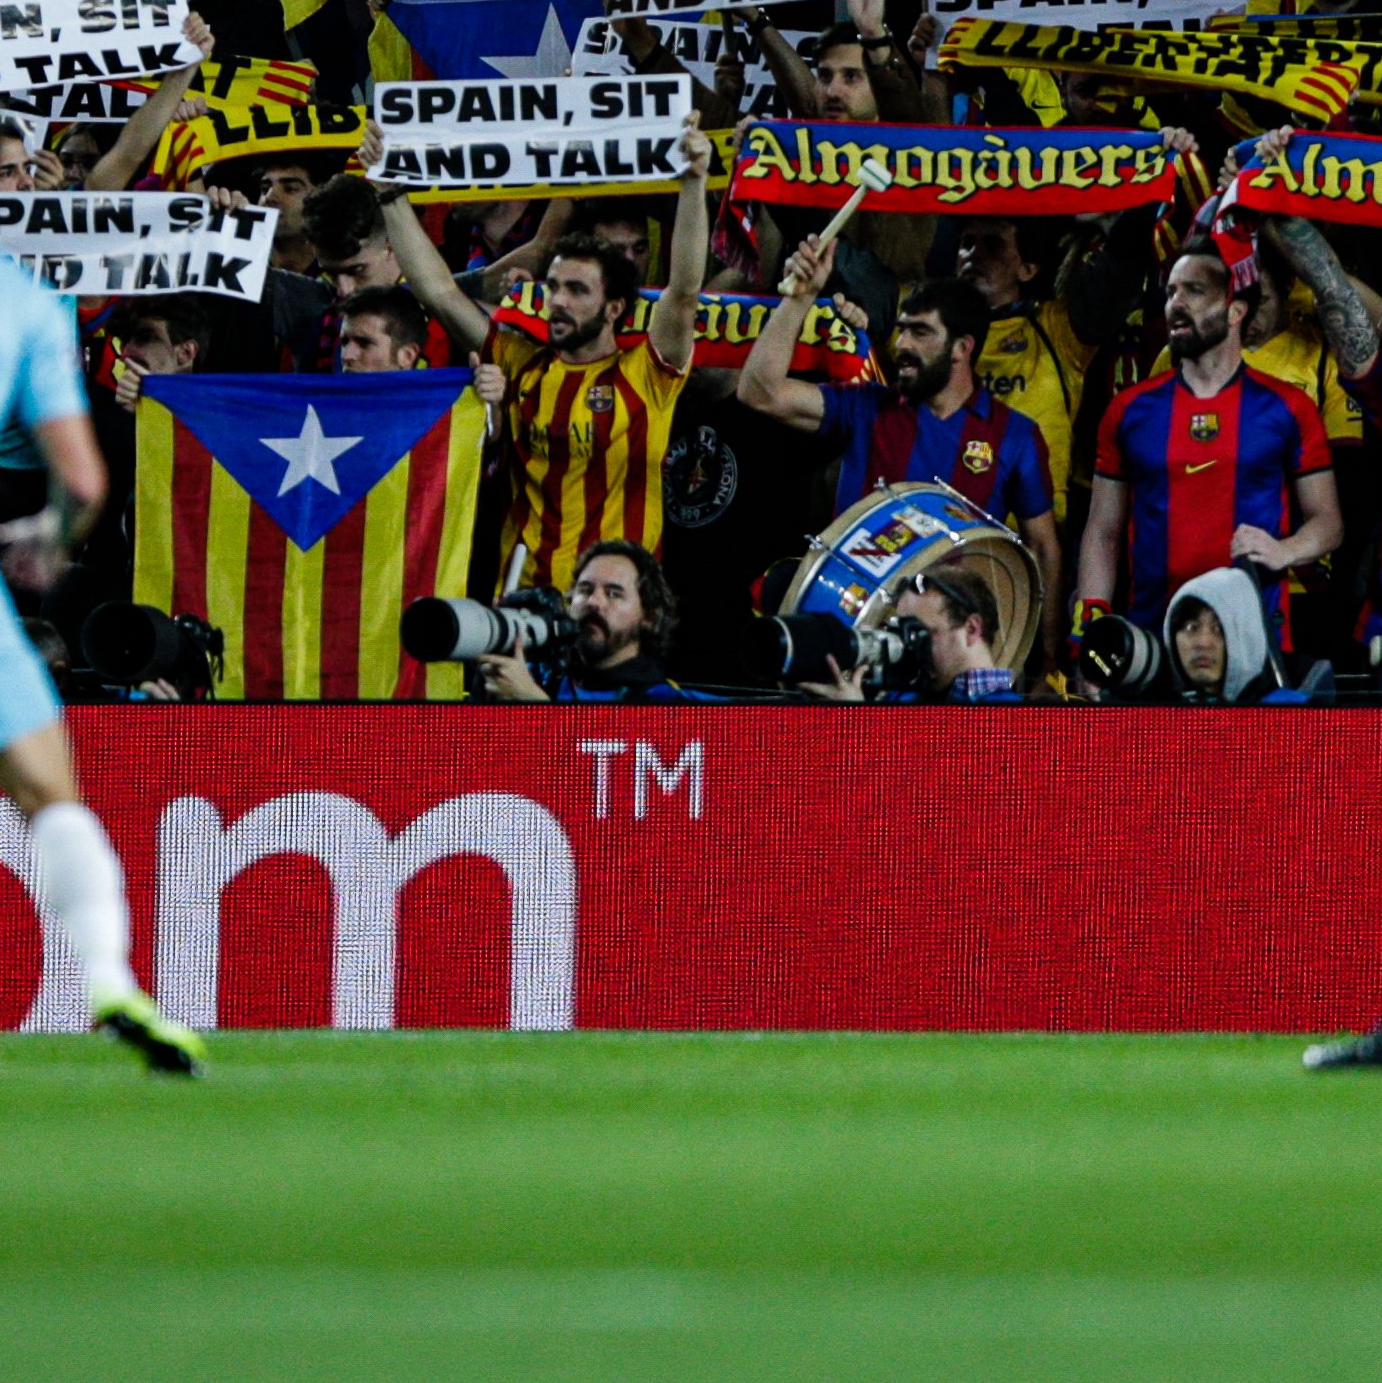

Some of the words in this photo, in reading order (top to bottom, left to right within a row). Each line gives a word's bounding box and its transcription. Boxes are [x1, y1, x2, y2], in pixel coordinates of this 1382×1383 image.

[13, 42, 185, 85] TALK
[380, 84, 574, 127] SPAIN,
[590, 80, 680, 119] SIT
[383, 141, 511, 181] AND
[526, 137, 678, 178] TALK
[168, 197, 266, 240] SIT
[103, 251, 253, 294] TALK
[578, 737, 706, 821] TM
